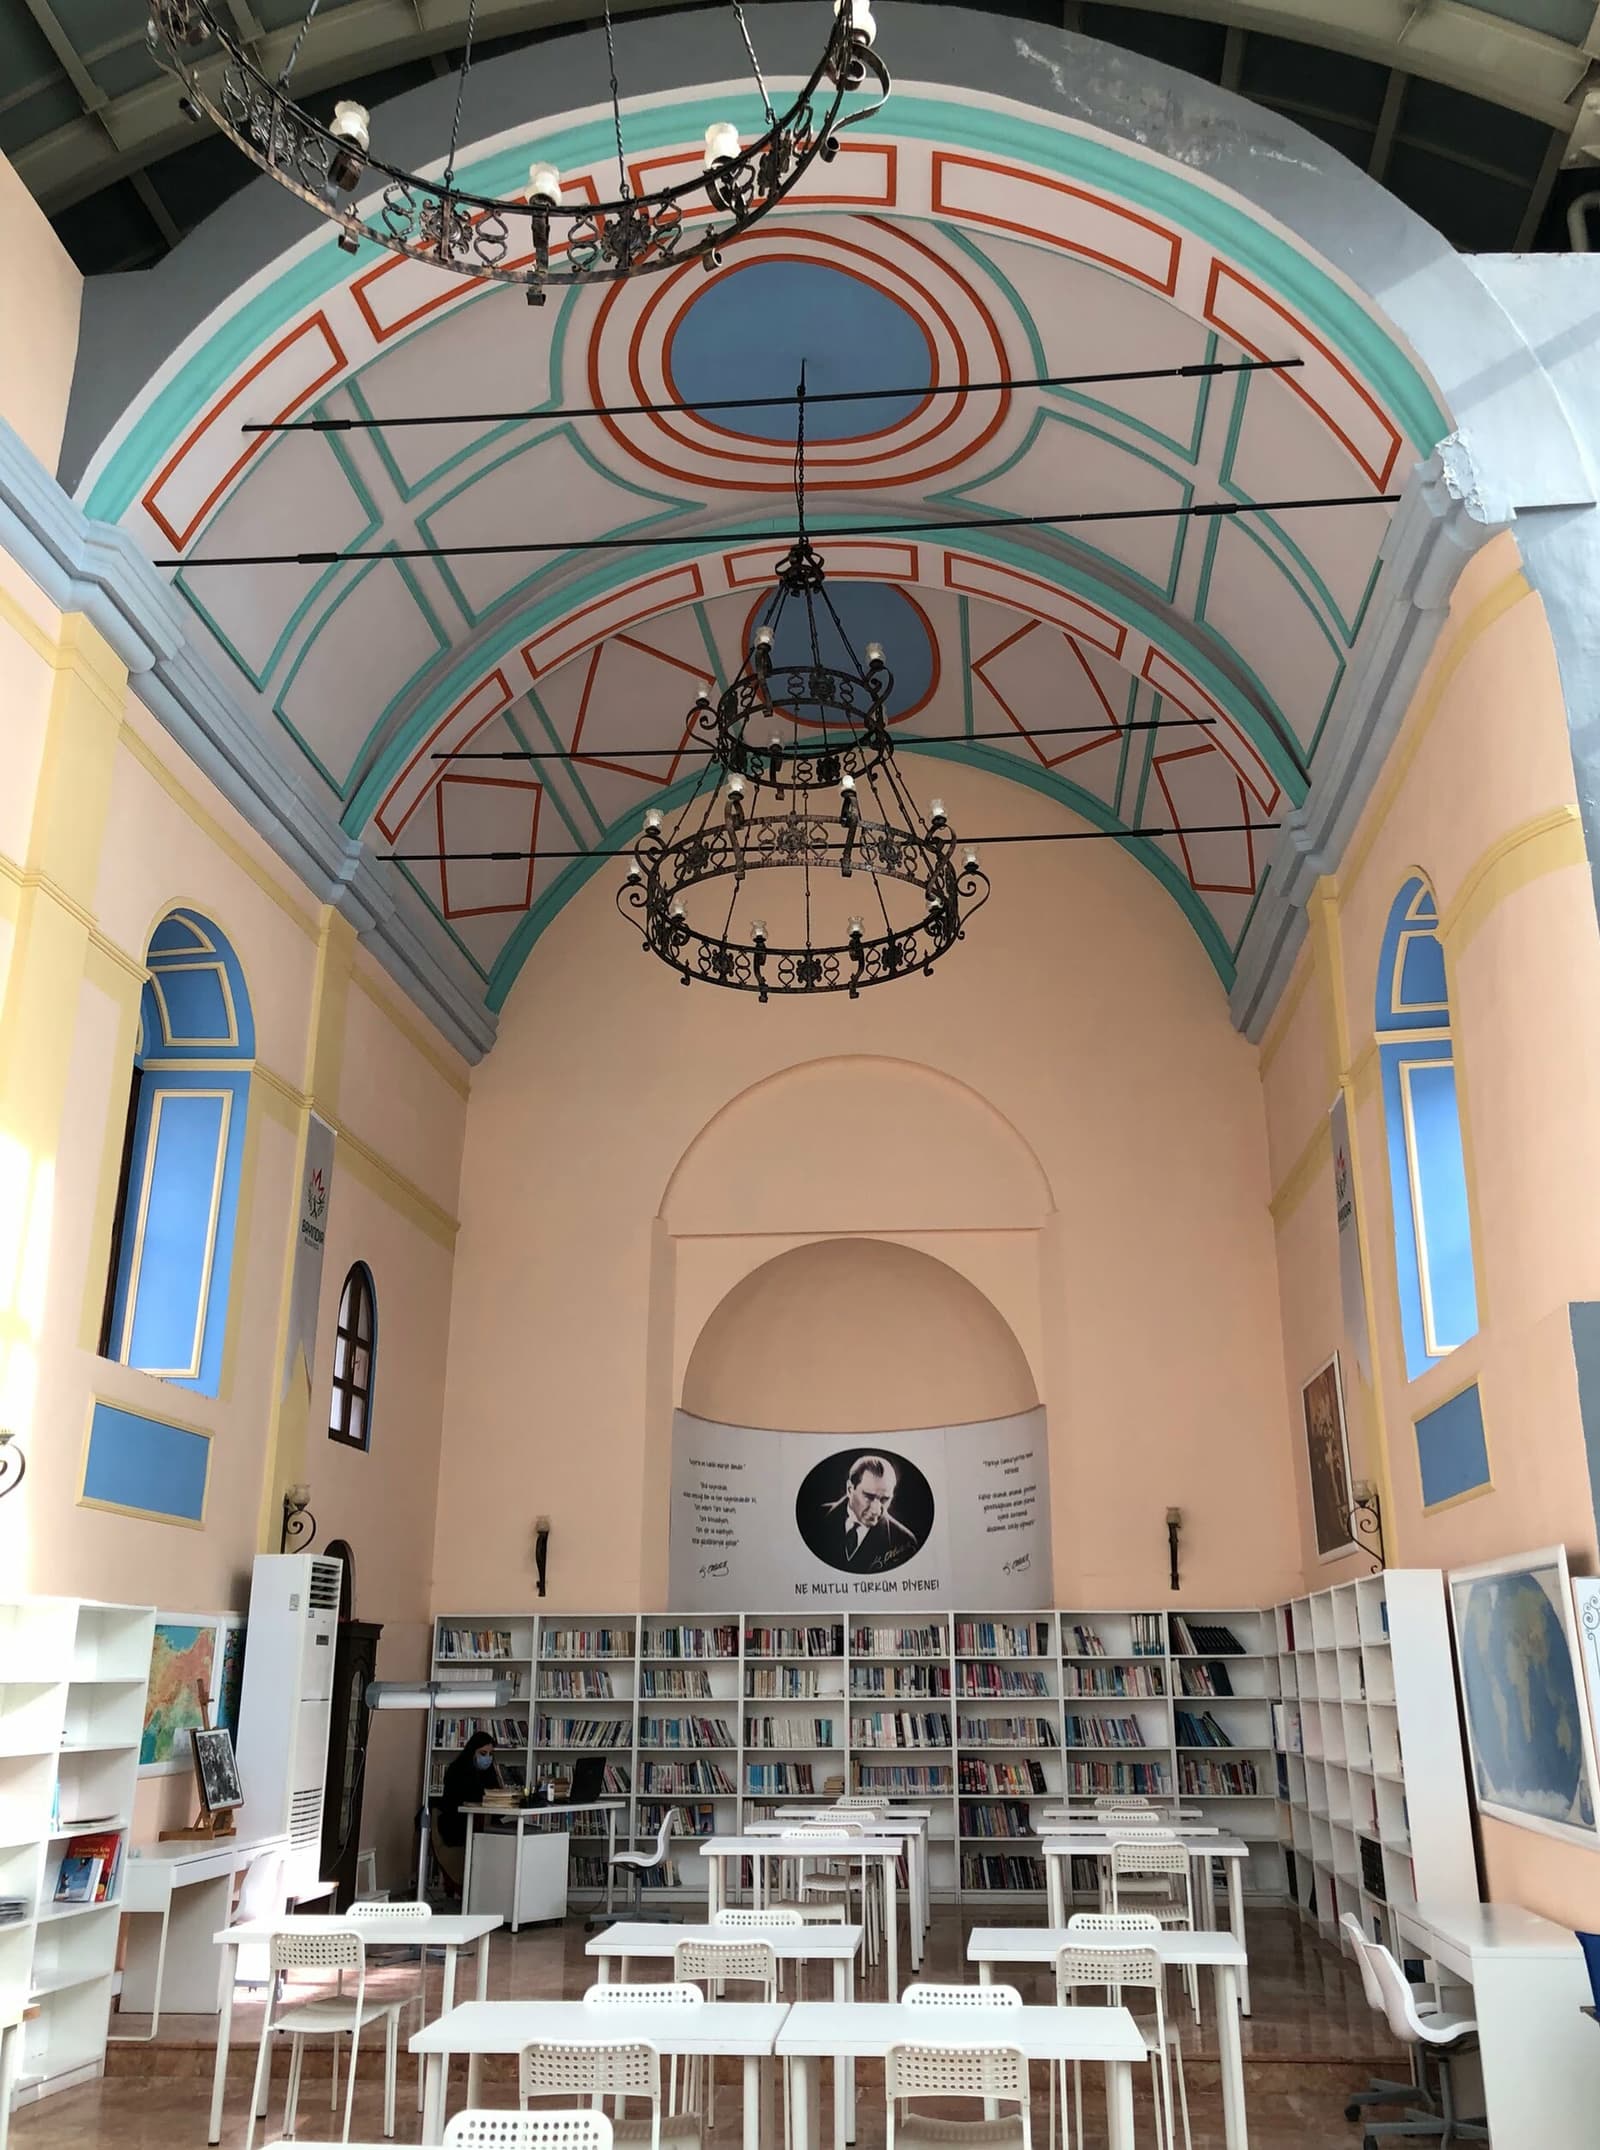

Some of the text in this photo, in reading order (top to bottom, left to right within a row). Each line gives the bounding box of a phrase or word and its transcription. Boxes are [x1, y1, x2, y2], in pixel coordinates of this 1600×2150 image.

[795, 1584, 808, 1594] NE
[812, 1583, 848, 1594] MUTLU
[853, 1581, 897, 1593] TÜRKÜM
